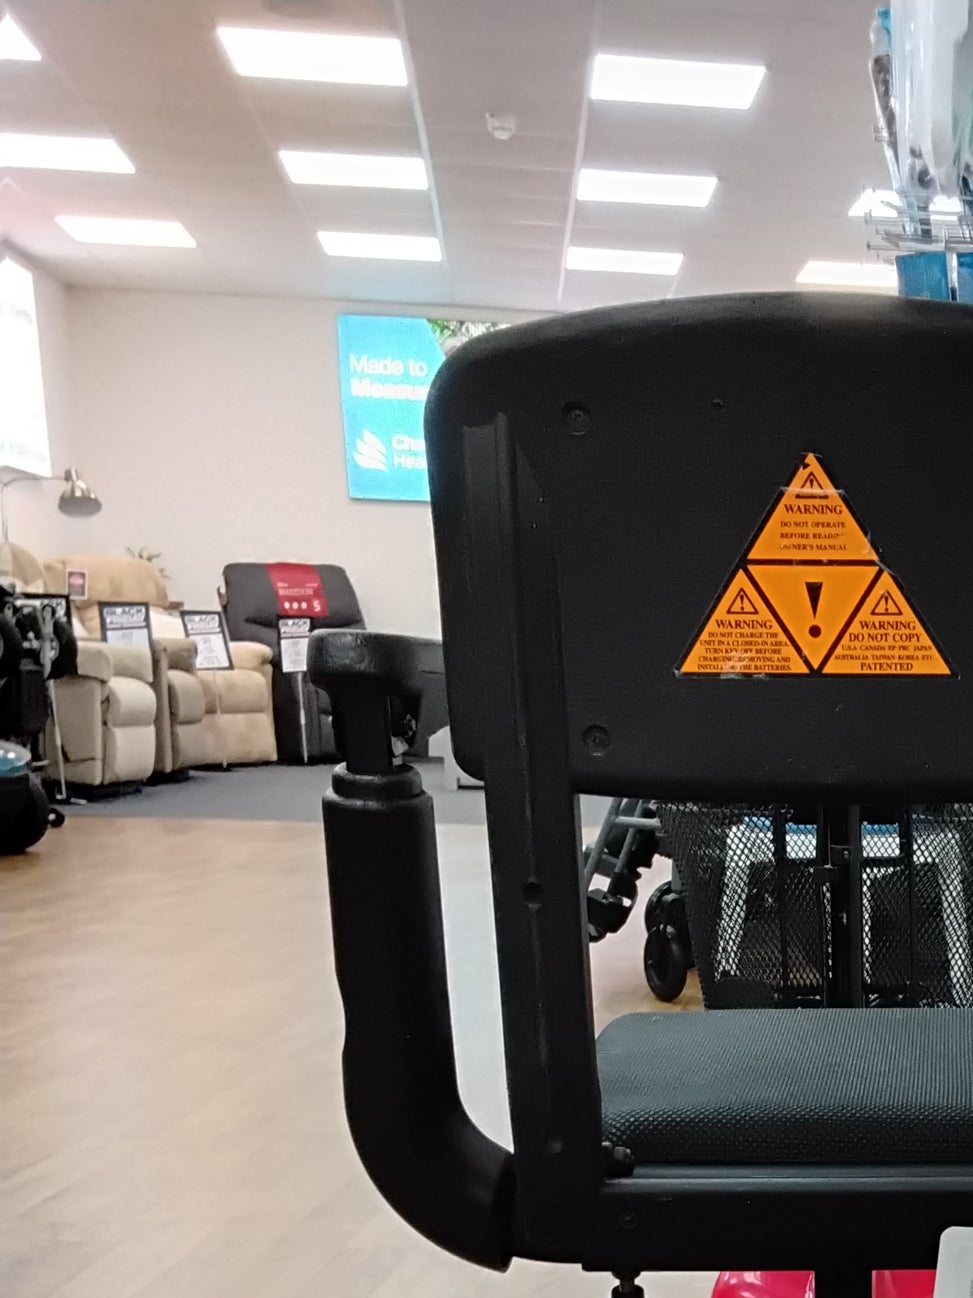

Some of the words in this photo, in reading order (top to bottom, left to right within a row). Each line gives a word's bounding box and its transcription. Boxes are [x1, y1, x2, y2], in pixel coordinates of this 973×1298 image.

[349, 353, 404, 375] Made
[408, 358, 428, 377] to
[393, 452, 426, 469] Hea
[784, 504, 843, 514] WARNING
[312, 599, 321, 612] 5
[715, 620, 772, 630] WARNING
[860, 621, 916, 630] WARNING
[849, 633, 864, 642] DO
[868, 633, 890, 642] NOT
[892, 633, 922, 642] COPY
[860, 663, 913, 671] PATENTED
